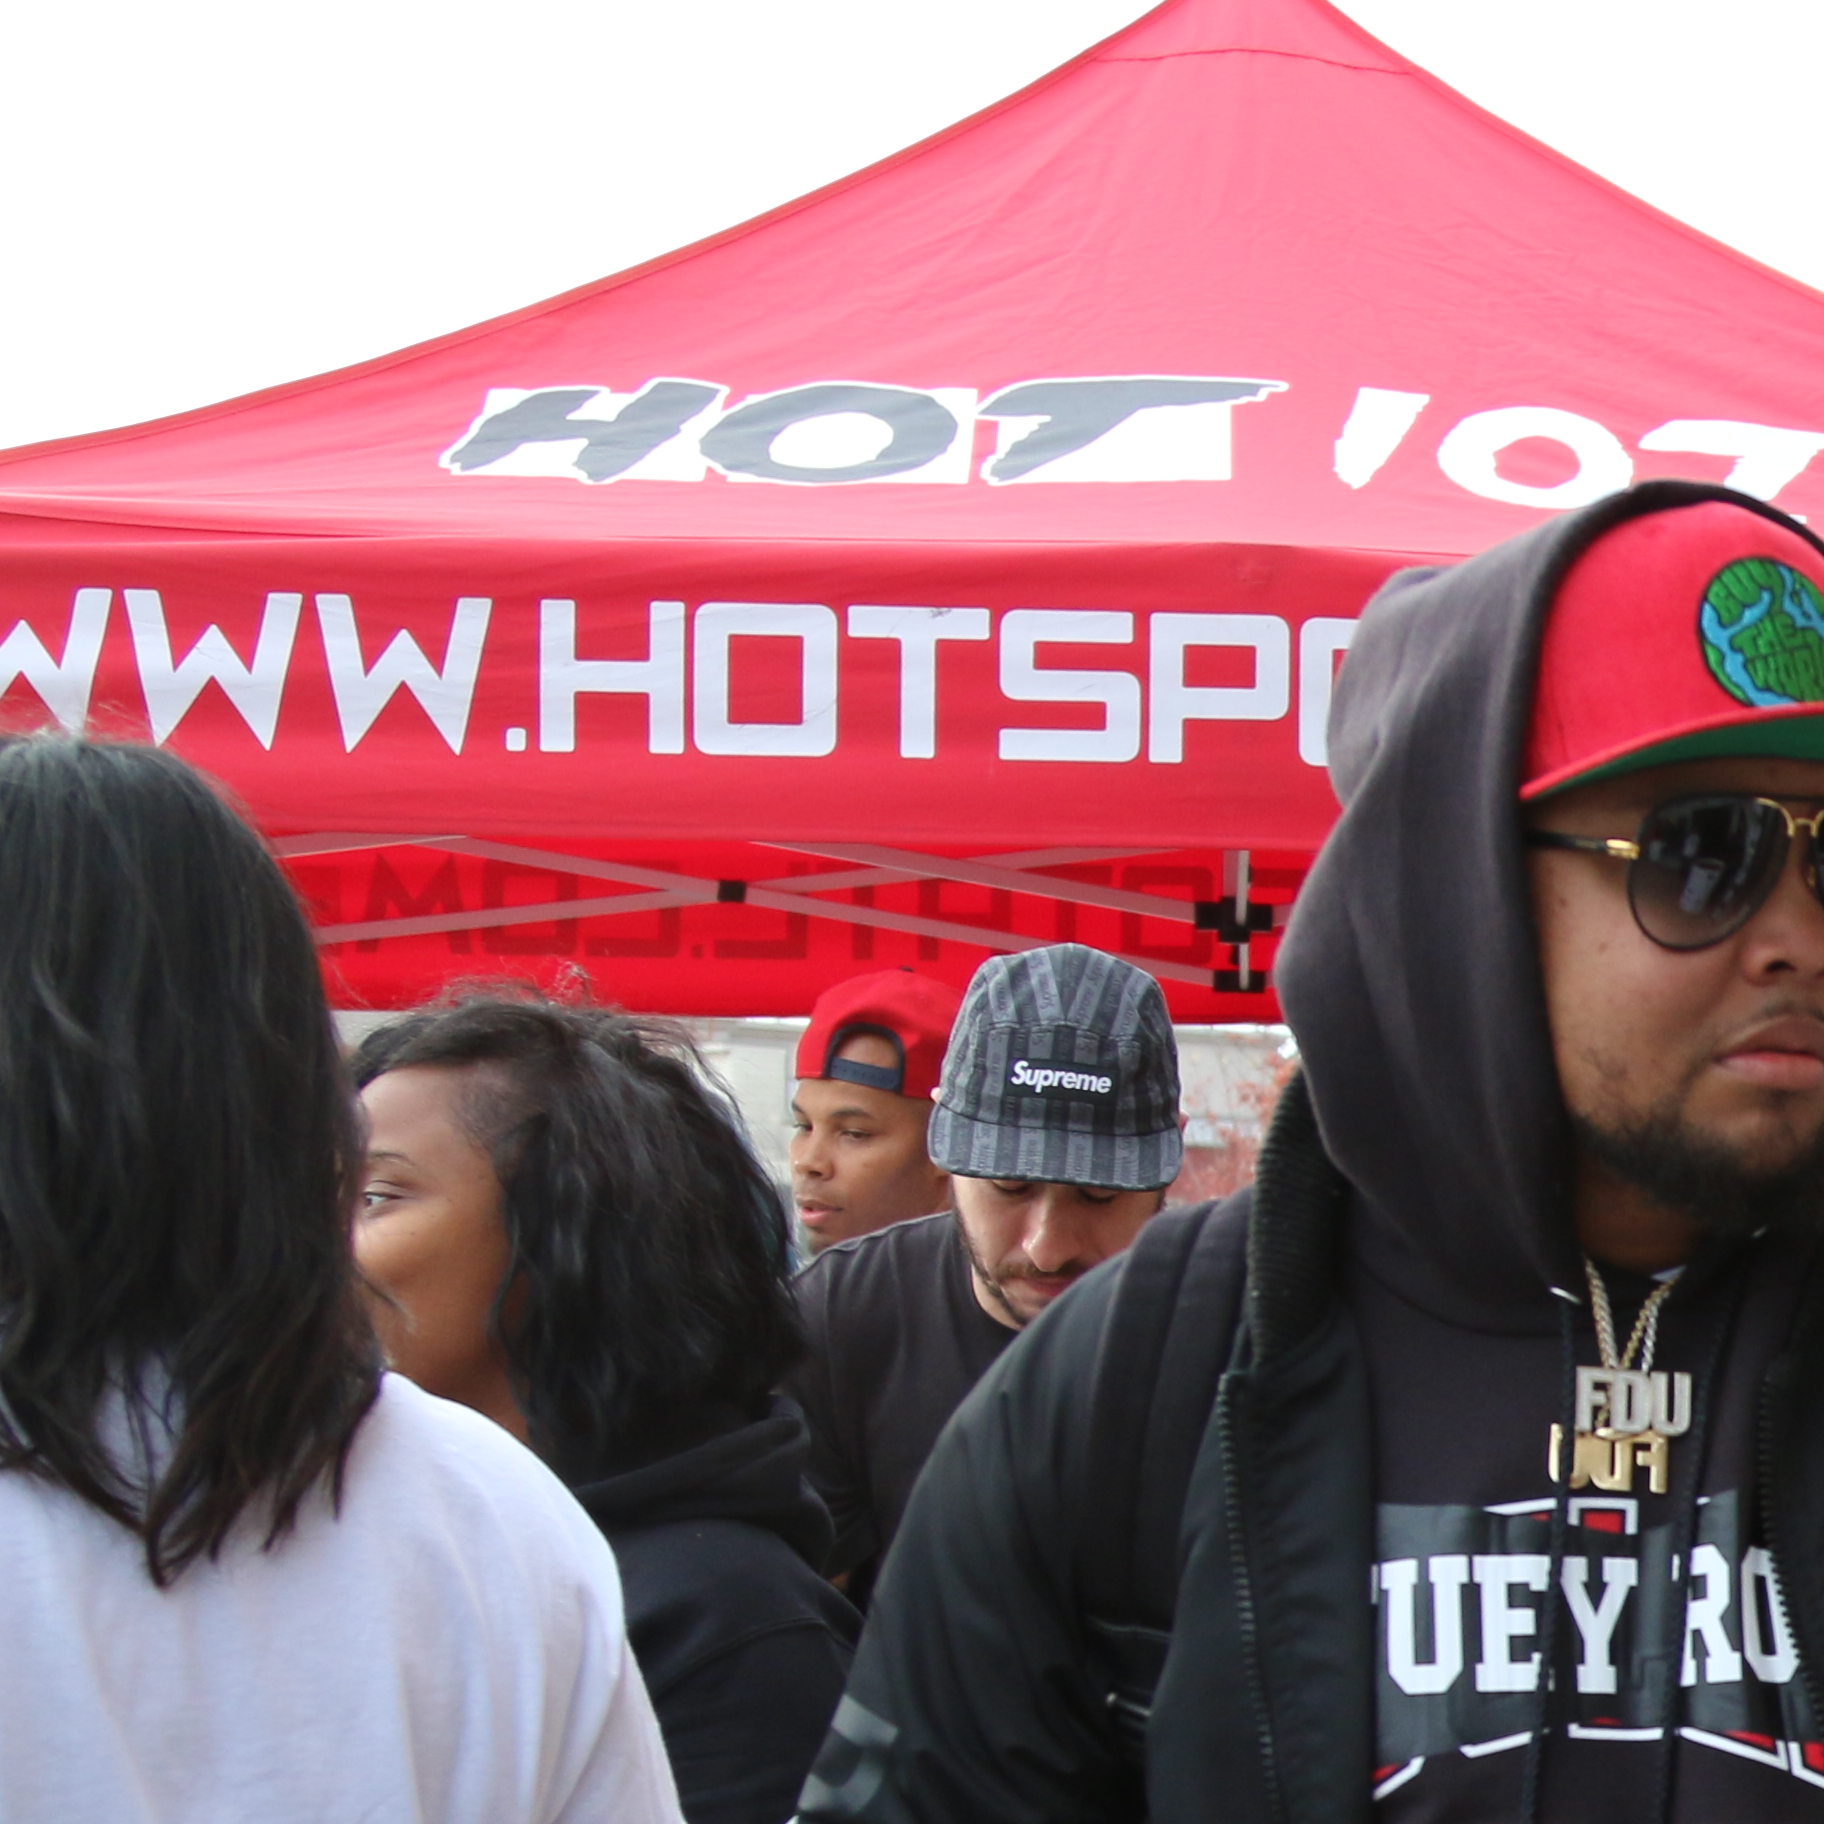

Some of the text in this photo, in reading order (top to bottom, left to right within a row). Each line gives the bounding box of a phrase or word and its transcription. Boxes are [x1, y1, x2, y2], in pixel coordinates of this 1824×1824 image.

[441, 376, 1288, 487] HOT
[1010, 1059, 1112, 1094] Supreme
[1574, 1365, 1692, 1436] FDU
[1371, 1552, 1638, 1696] UEY
